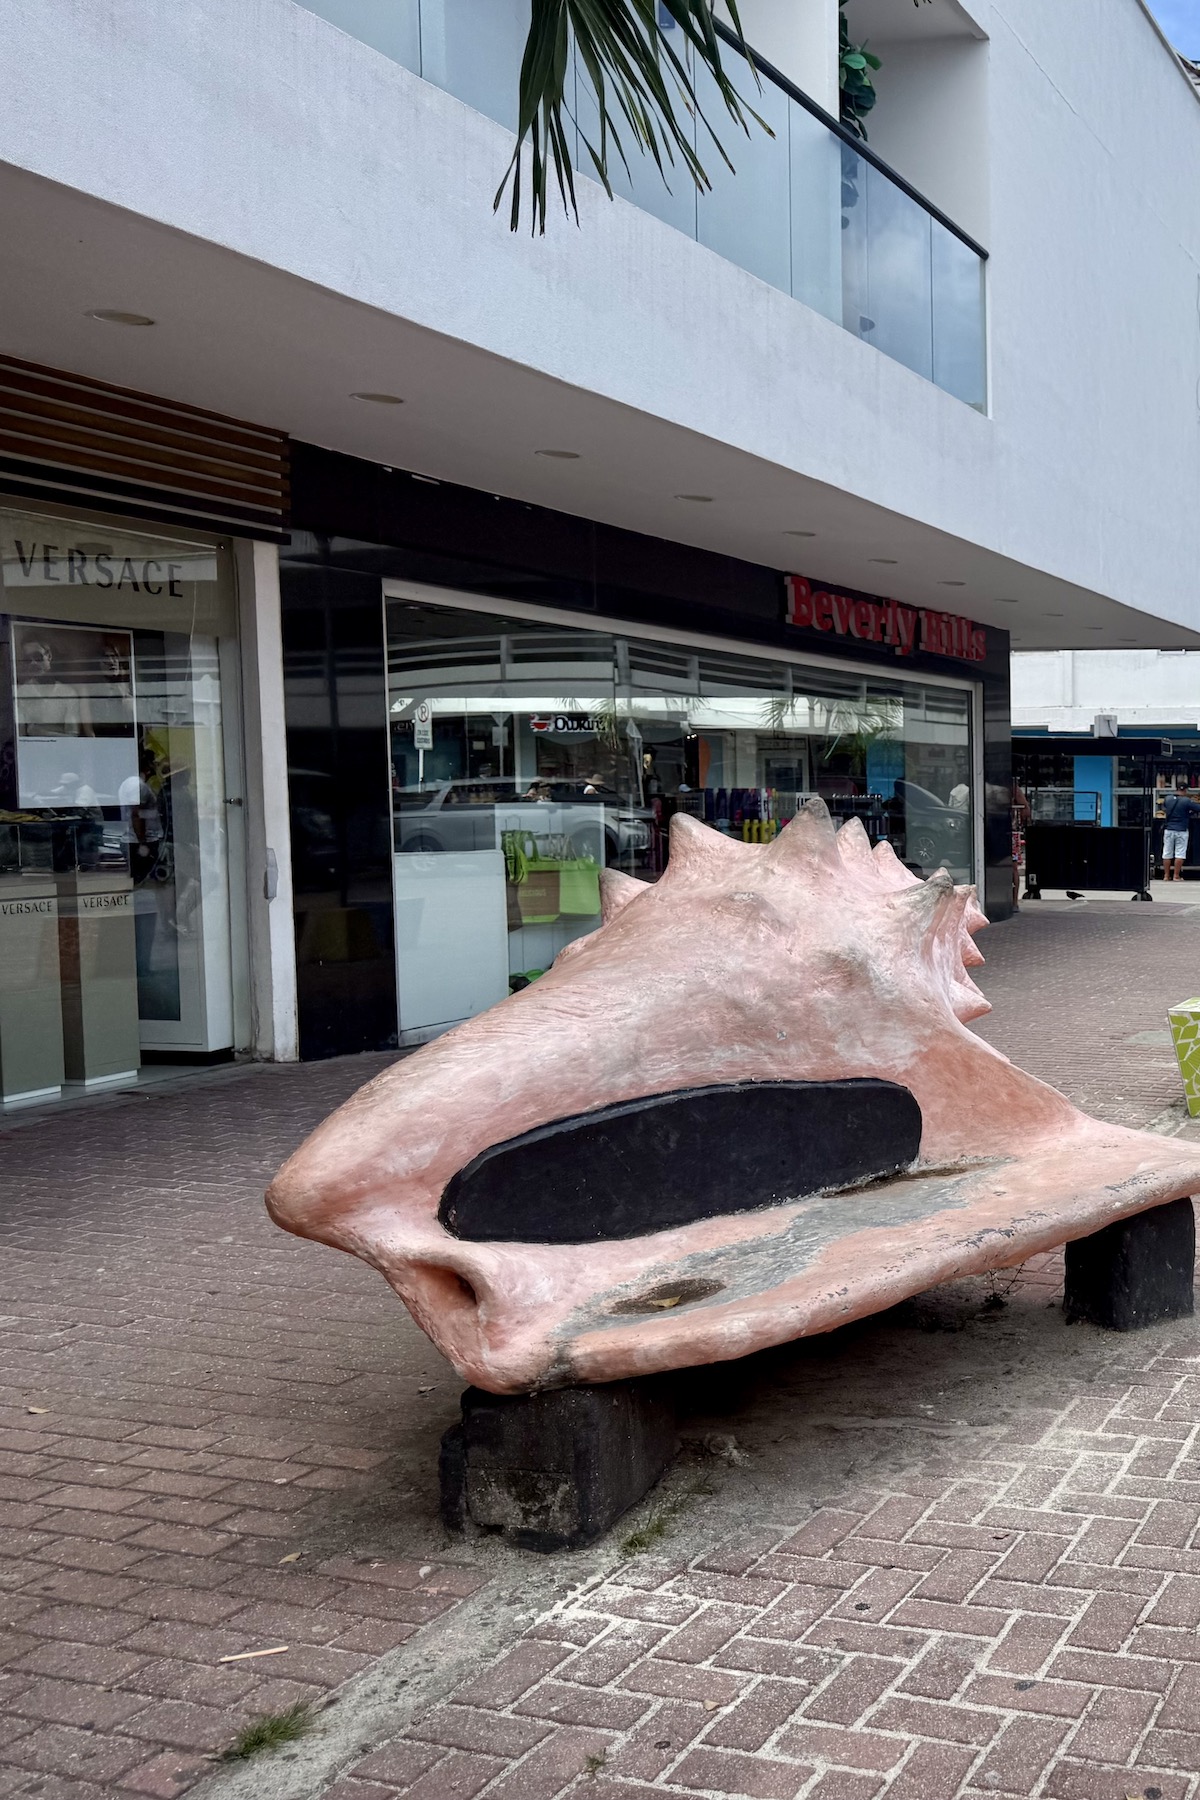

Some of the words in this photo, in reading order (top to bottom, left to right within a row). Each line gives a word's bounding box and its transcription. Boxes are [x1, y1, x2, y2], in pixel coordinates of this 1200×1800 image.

[14, 540, 184, 598] VERSACE
[784, 576, 917, 656] Beverly
[919, 610, 987, 662] Hills
[2, 901, 53, 915] VERSACE
[83, 895, 130, 908] VERSACE
